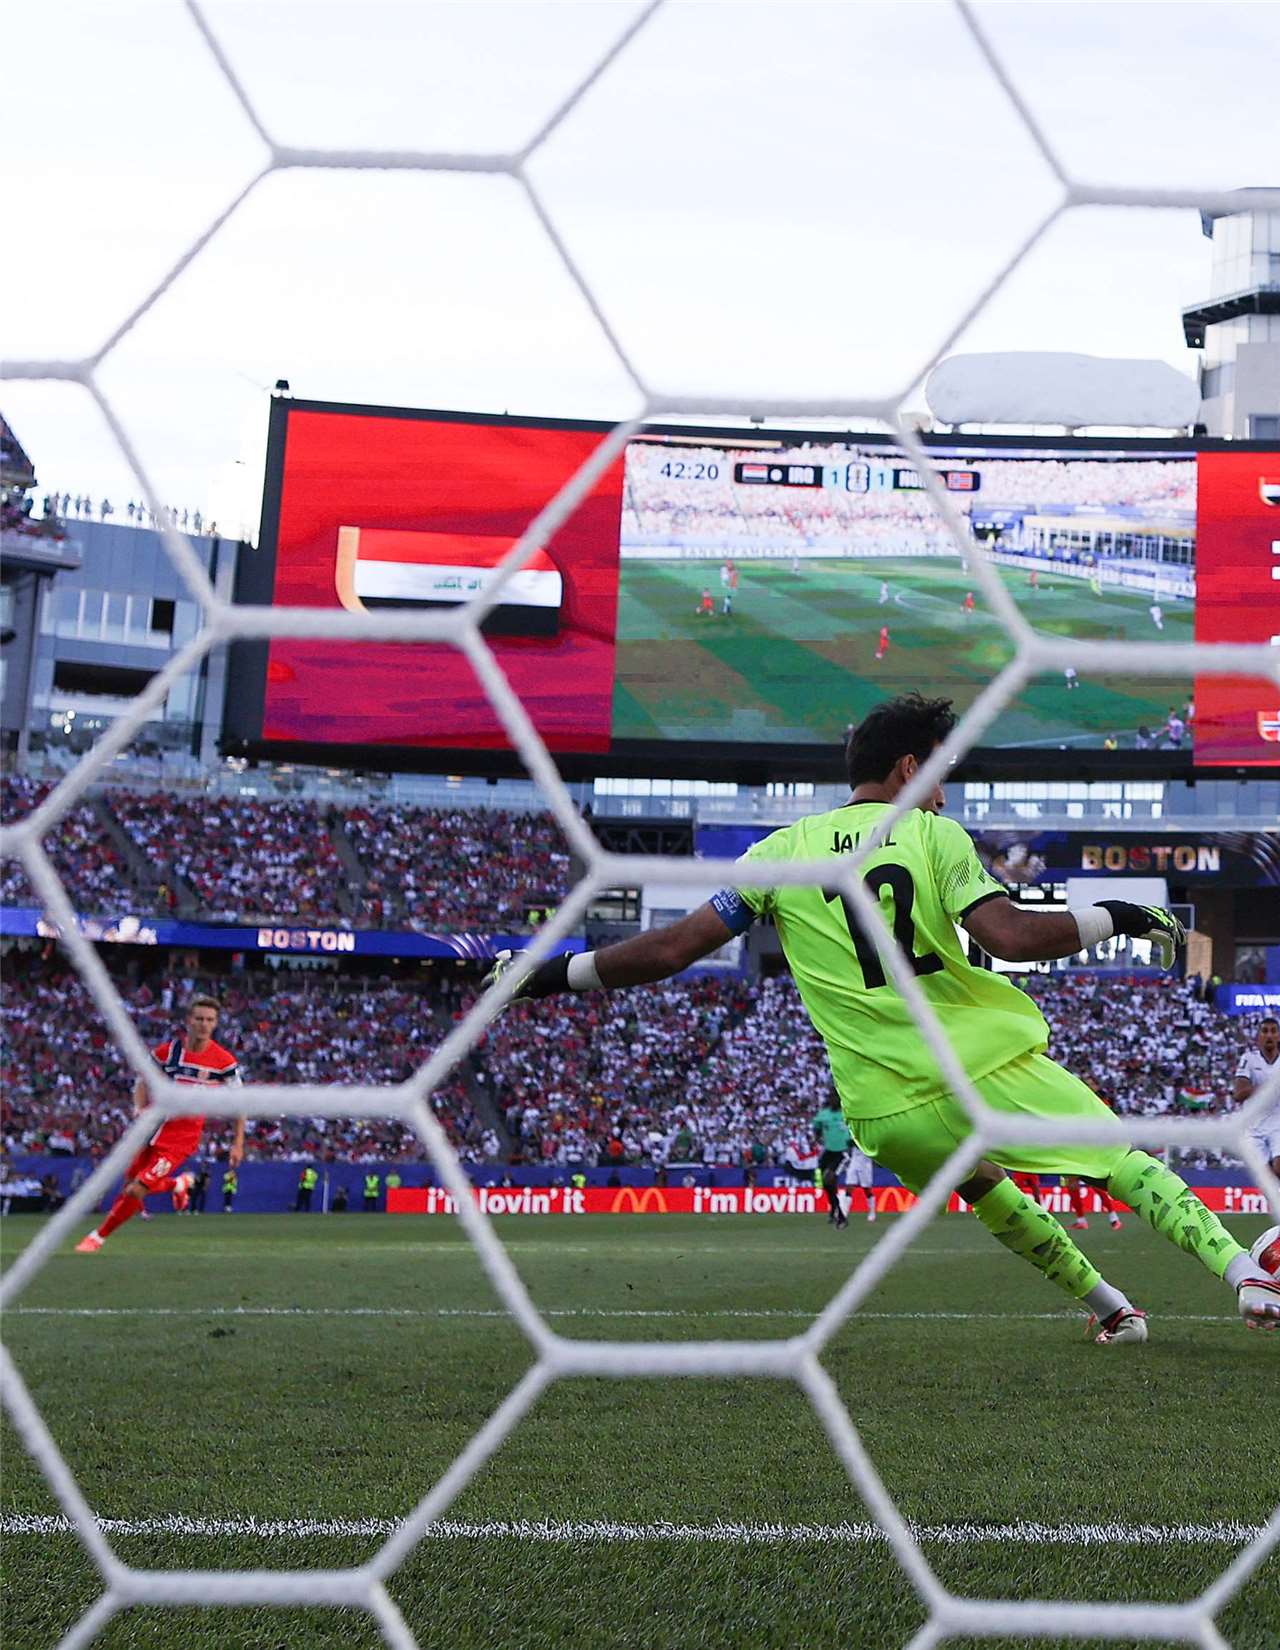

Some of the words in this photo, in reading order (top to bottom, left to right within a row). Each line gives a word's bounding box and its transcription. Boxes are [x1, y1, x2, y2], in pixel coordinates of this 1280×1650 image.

[660, 462, 720, 481] 42:20
[830, 826, 897, 853] JAL
[1081, 845, 1220, 872] BOSTON
[821, 862, 945, 990] 12
[257, 928, 355, 952] BOSTON
[480, 1188, 558, 1214] lovin'
[563, 1187, 585, 1214] it
[694, 1187, 738, 1214] i'm
[744, 1187, 823, 1214] lovin'
[1224, 1187, 1268, 1214] i'm
